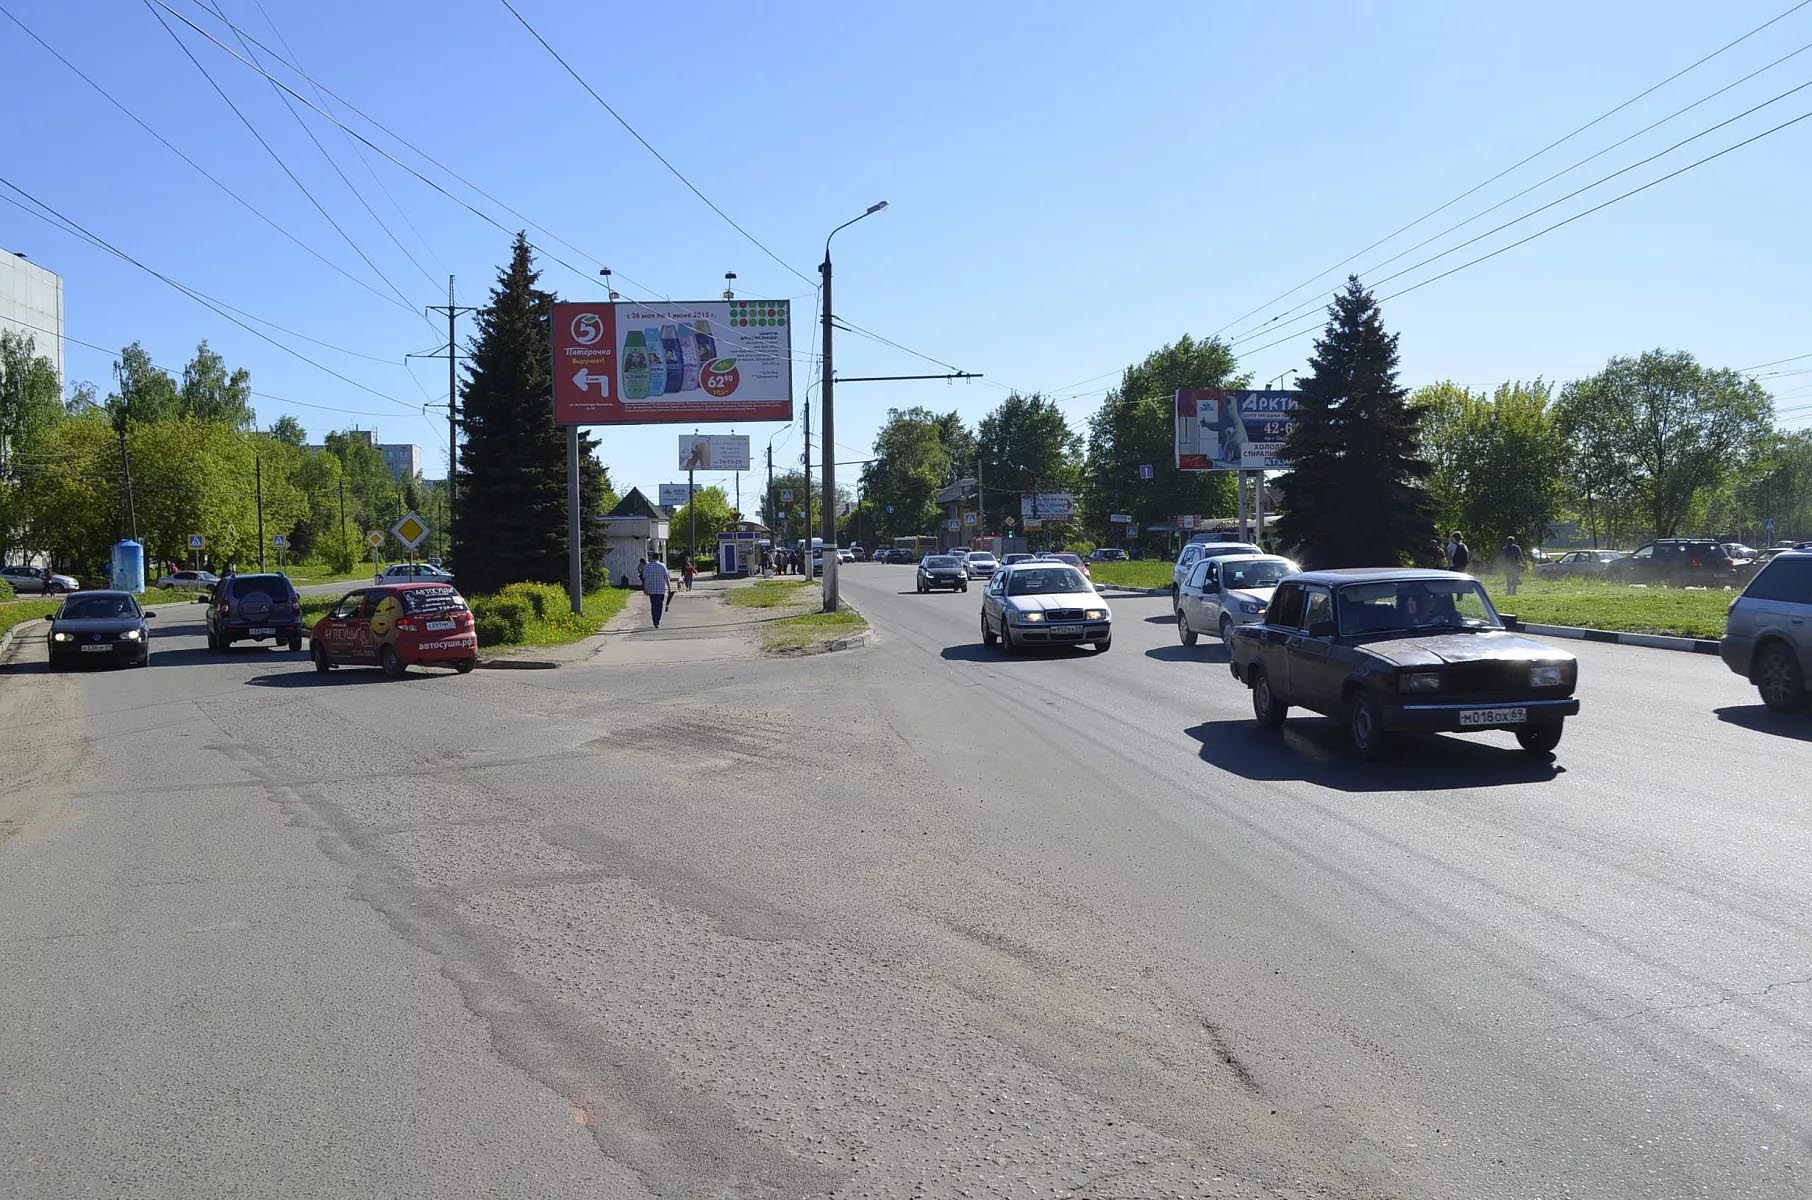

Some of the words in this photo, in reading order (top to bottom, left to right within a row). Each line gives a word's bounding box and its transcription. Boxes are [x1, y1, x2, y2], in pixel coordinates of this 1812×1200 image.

[708, 375, 725, 388] 62
[724, 374, 734, 382] 90
[419, 638, 473, 650] автосуши.рф
